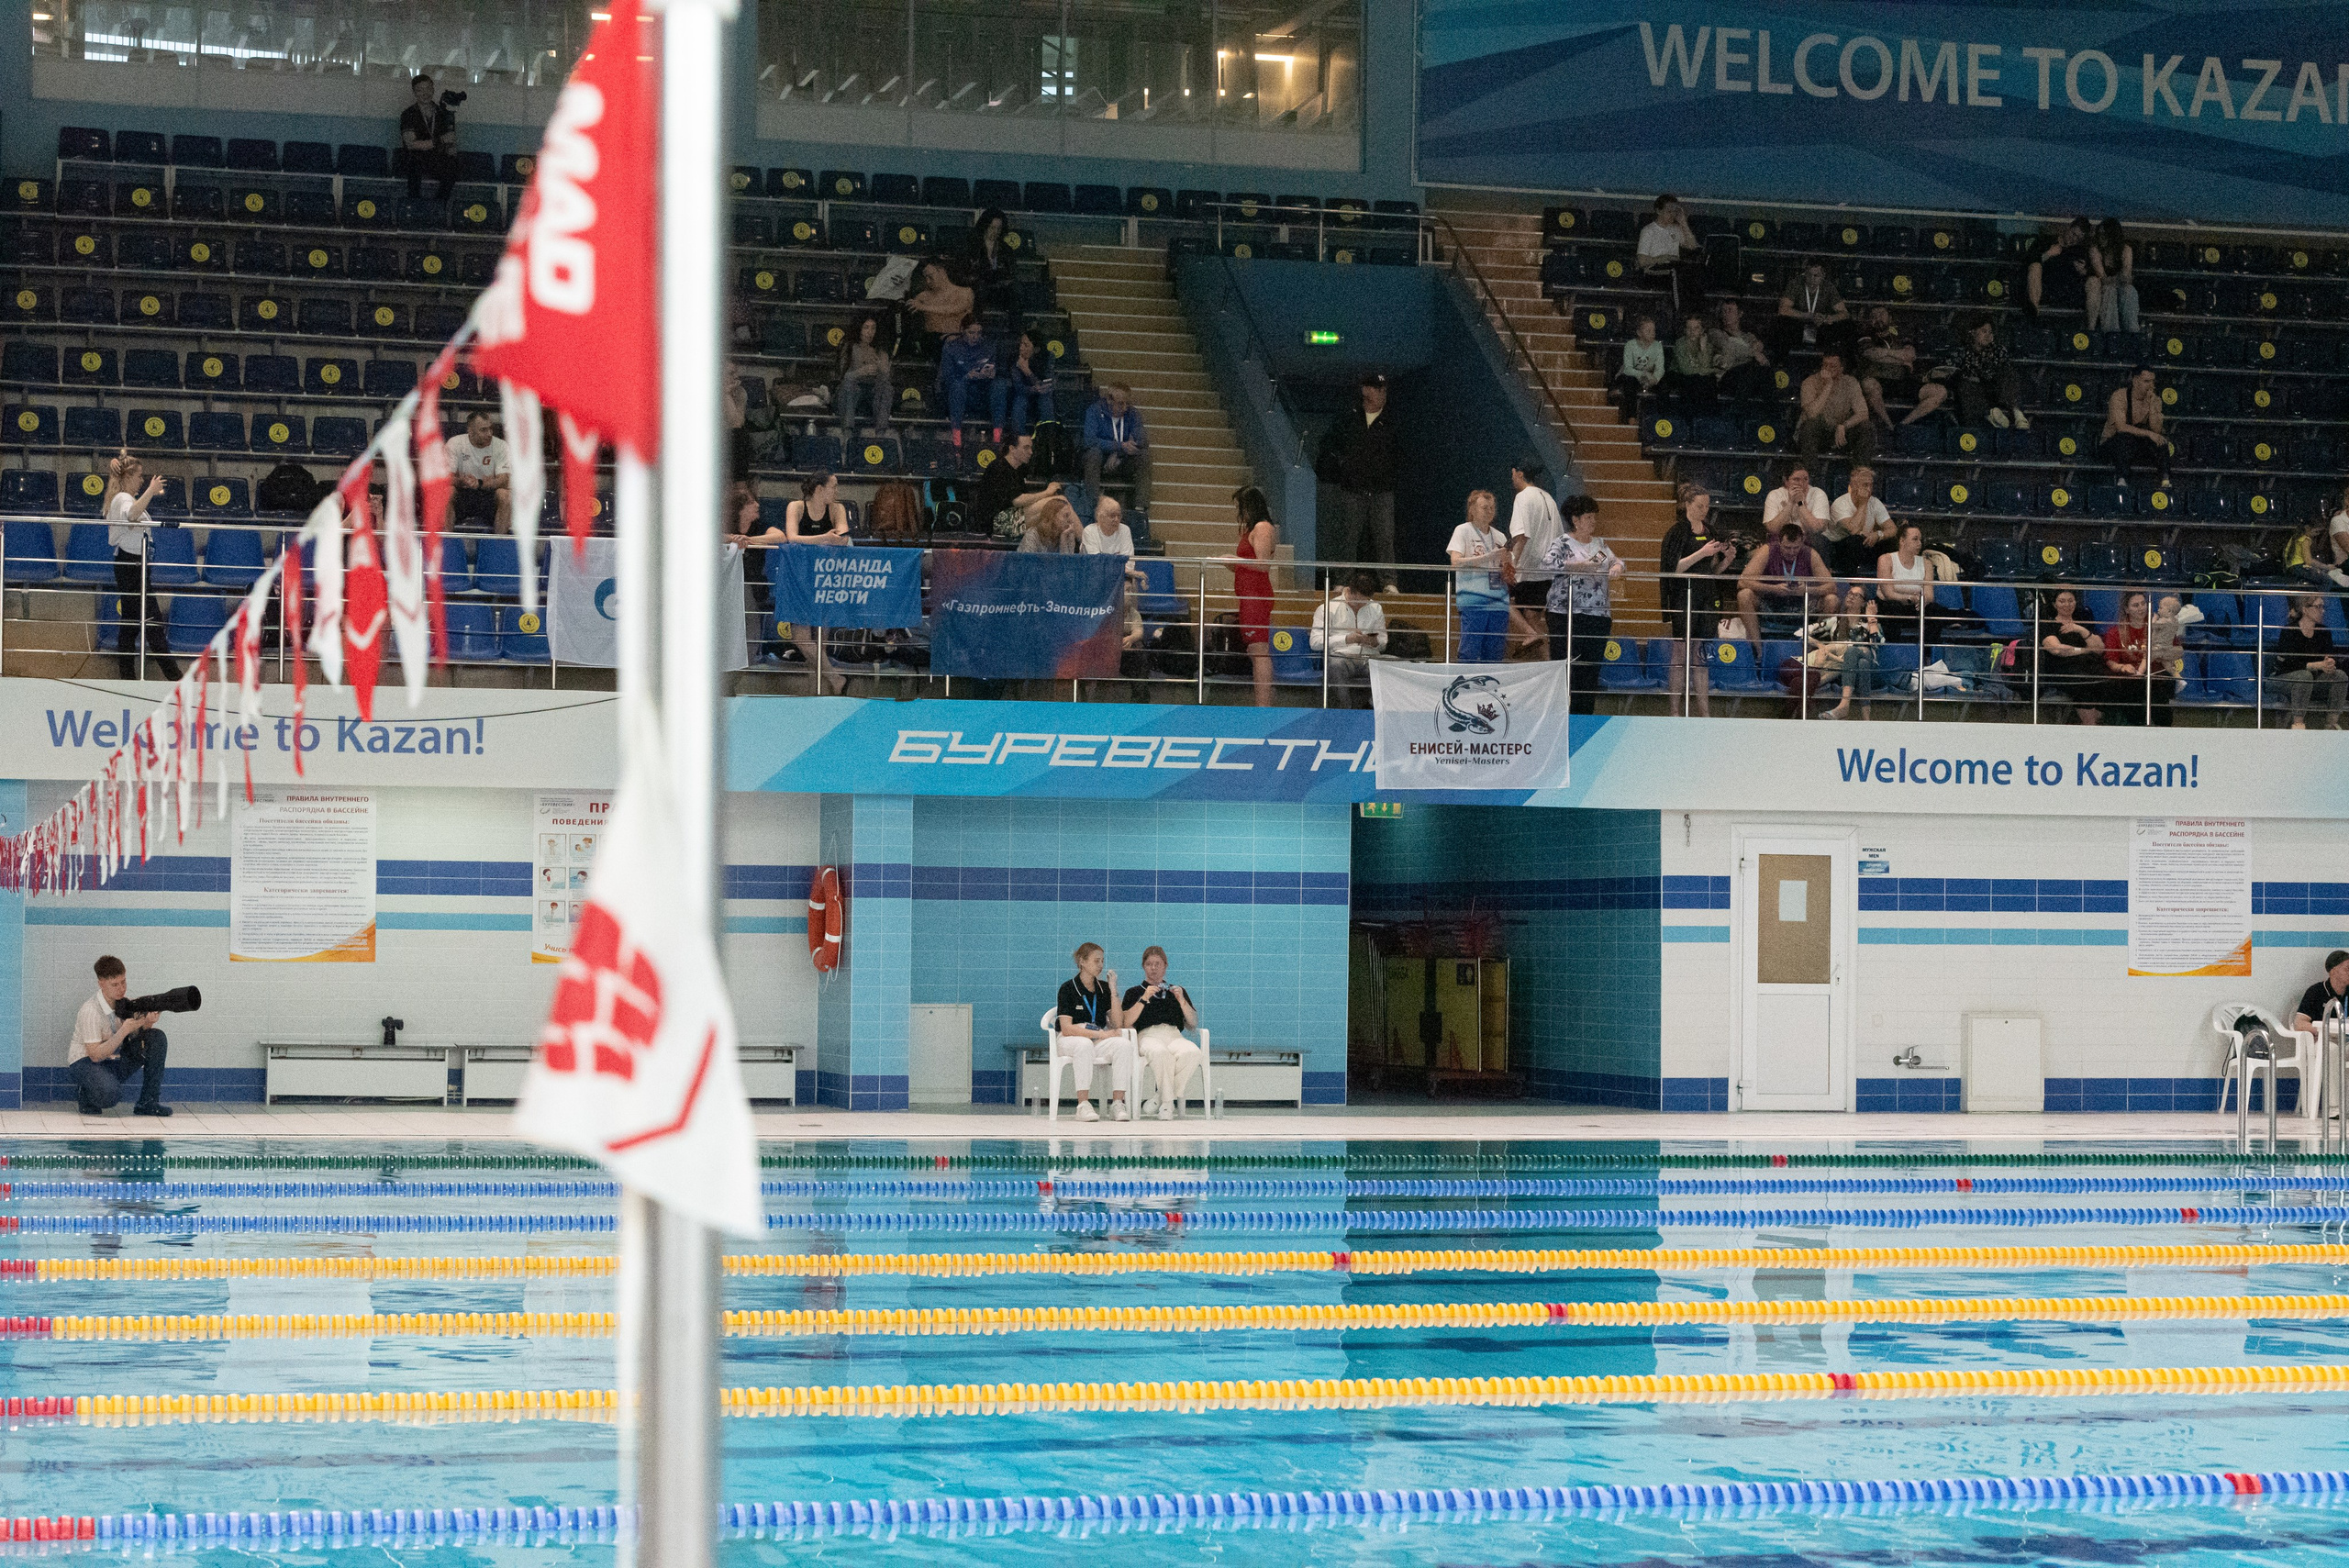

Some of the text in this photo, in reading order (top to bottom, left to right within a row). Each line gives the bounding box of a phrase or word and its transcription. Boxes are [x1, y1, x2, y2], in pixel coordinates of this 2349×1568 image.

[1639, 21, 2003, 107] WELCOME
[2022, 46, 2119, 114] TO
[529, 81, 604, 317] MAD
[814, 558, 893, 573] КОМАНДА
[814, 573, 887, 589] ГАЗПРОМ
[814, 589, 869, 605] НЕФТИ
[273, 717, 320, 752] to
[338, 715, 484, 755] Kazan!
[1409, 740, 1532, 755] ЕНИСЕЙ-МАСТЕРС
[888, 730, 1376, 773] БУРЕВЕСТН
[1434, 757, 1510, 765] Yenisei-Masters
[1836, 747, 2199, 788] Welcome to Kazan!
